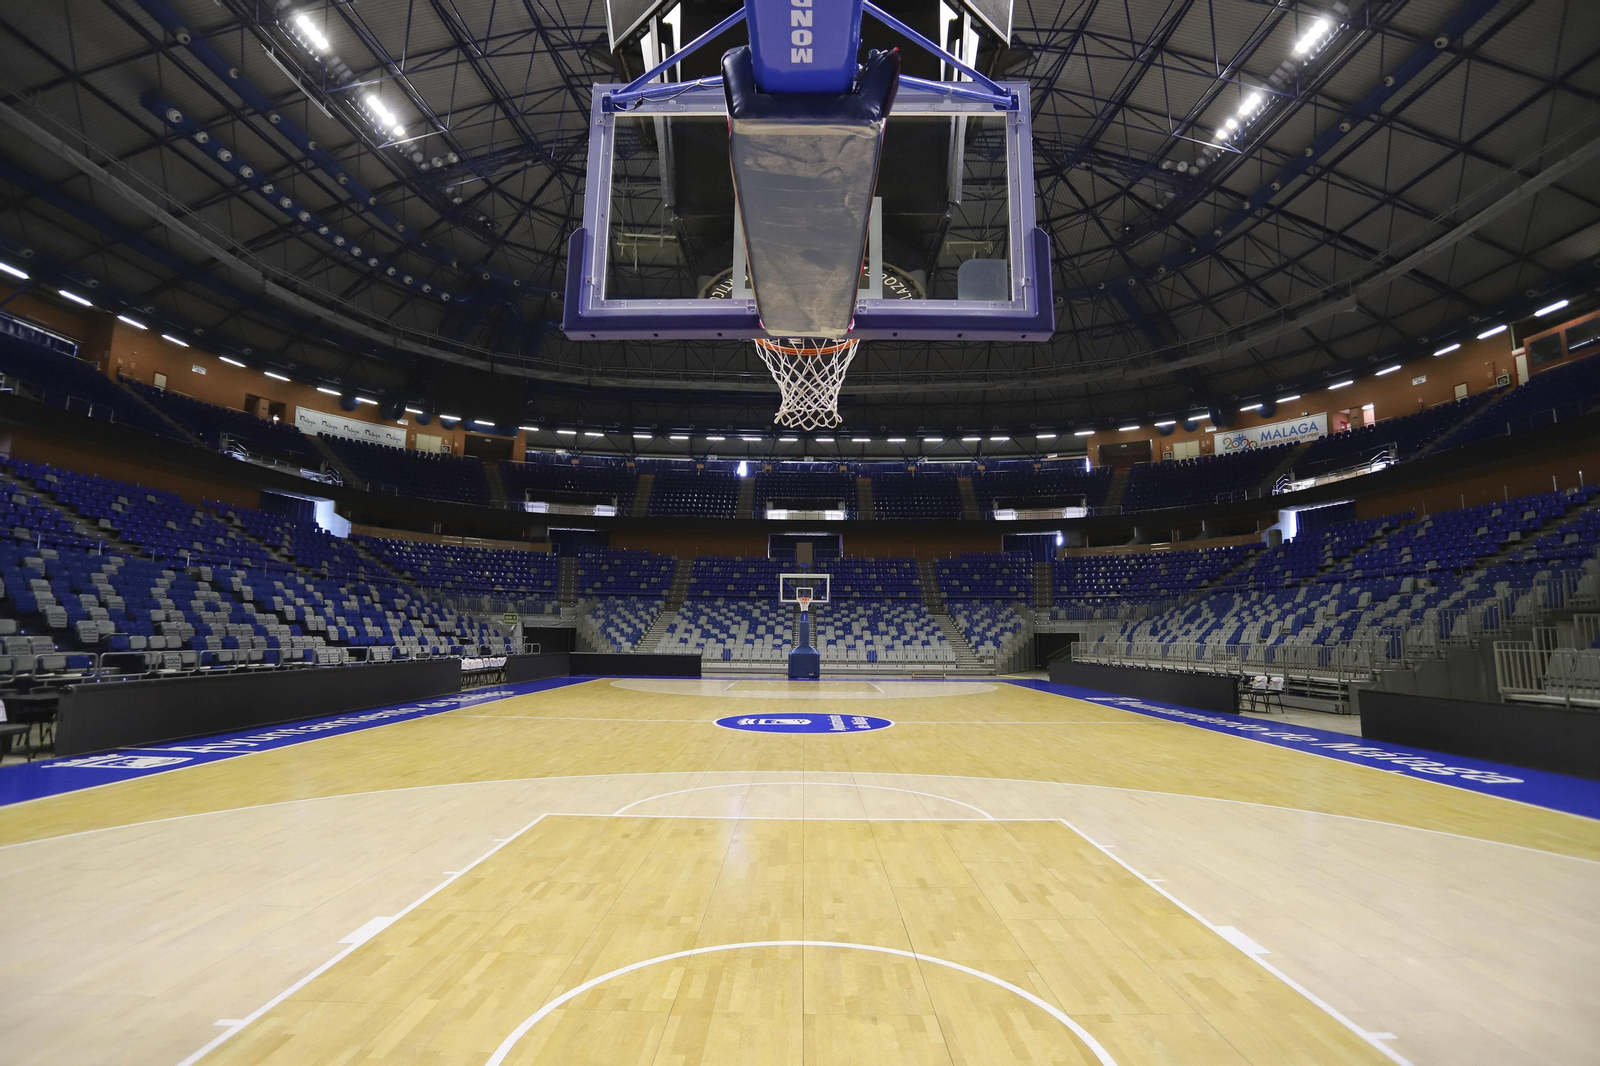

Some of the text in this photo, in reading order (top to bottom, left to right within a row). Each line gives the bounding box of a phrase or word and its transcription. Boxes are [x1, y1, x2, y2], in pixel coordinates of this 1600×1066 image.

[1260, 421, 1319, 441] MÁLAGA
[168, 707, 426, 753] Ayuntamiento
[1261, 732, 1319, 742] de
[1309, 742, 1525, 784] Málaga
